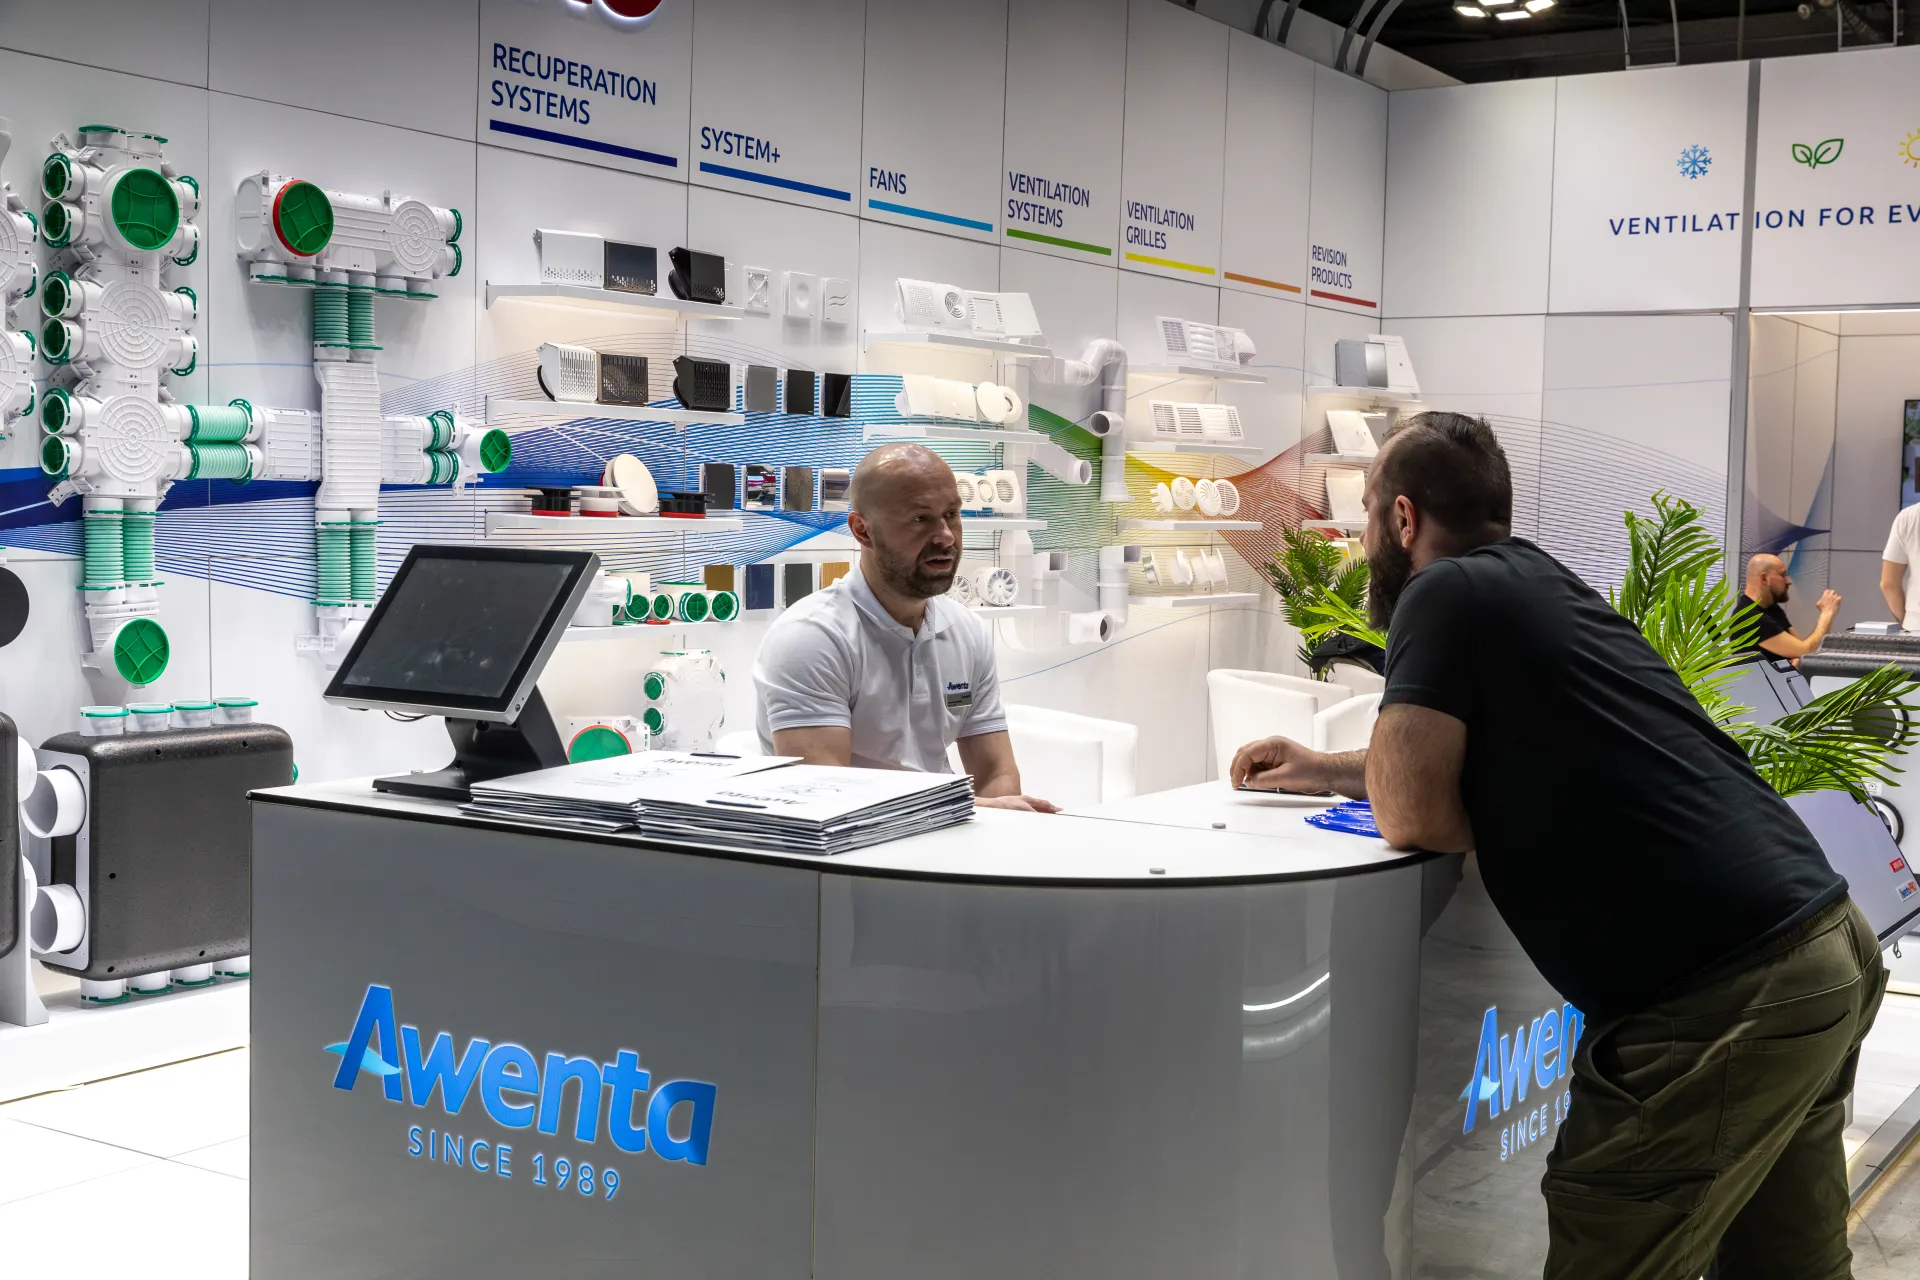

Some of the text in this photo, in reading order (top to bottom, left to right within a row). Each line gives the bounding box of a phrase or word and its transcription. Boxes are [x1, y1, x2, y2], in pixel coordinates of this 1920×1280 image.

[492, 42, 656, 106] RECUPERATION
[490, 80, 591, 126] SYSTEMS
[700, 126, 781, 164] SYSTEM+
[869, 167, 907, 195] FANS
[1008, 171, 1090, 208] VENTILATION
[1007, 199, 1064, 229] SYSTEMS
[1126, 200, 1195, 232] VENTILATION
[1609, 204, 1920, 235] VENTILATION FOR EV
[1125, 225, 1167, 250] GRILLES
[1311, 244, 1347, 267] REVISION
[1311, 266, 1353, 290] PRODUCTS
[323, 983, 718, 1166] Awenta
[1501, 1104, 1548, 1161] SINCE
[408, 1126, 621, 1200] SINCE 1989
